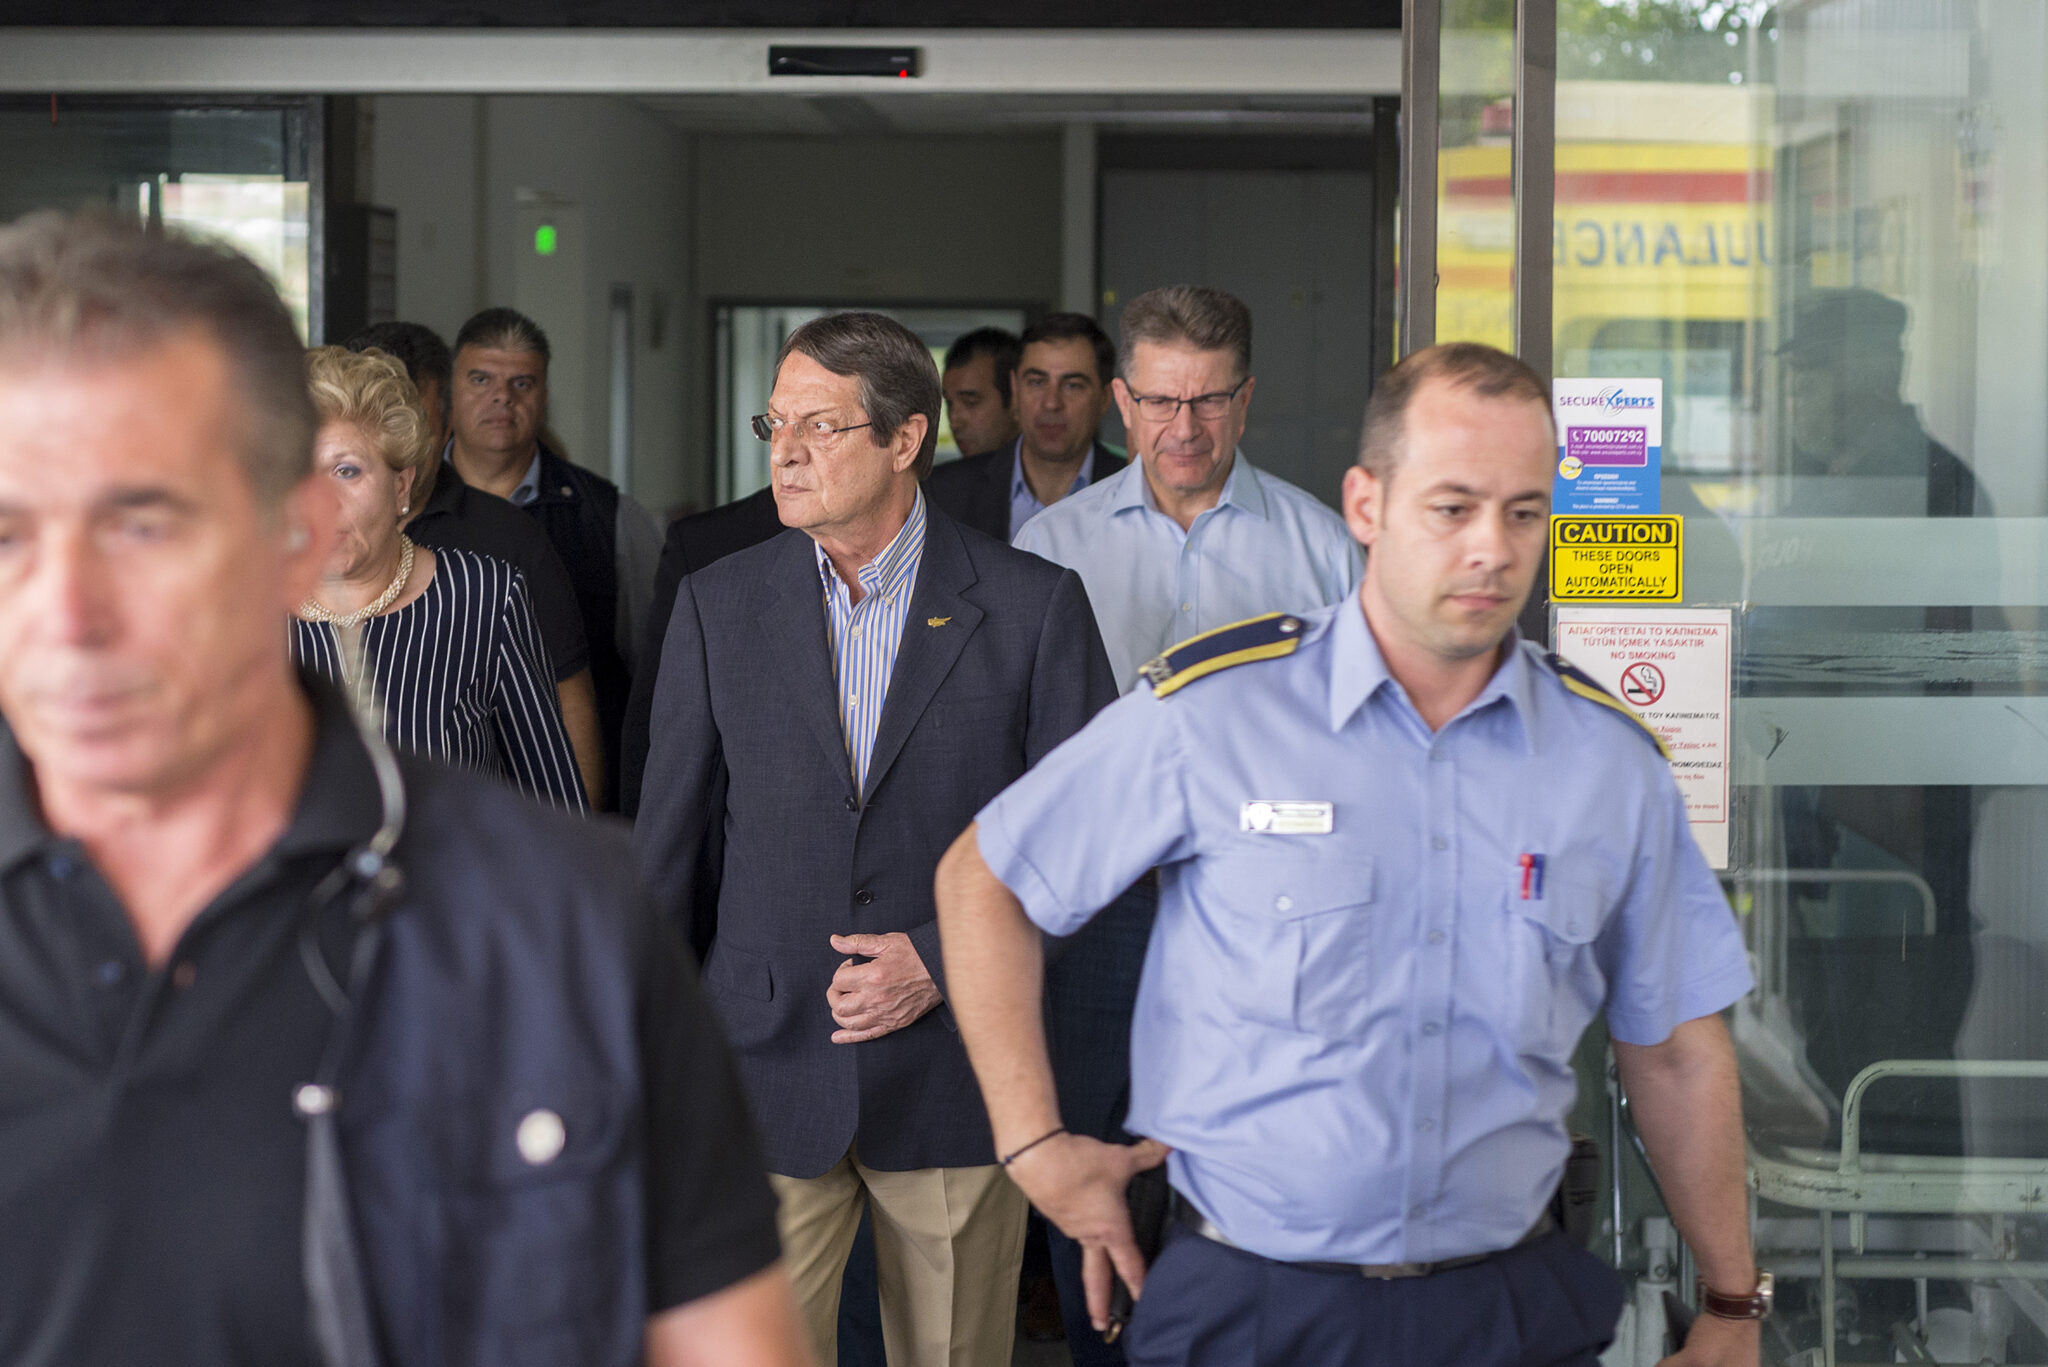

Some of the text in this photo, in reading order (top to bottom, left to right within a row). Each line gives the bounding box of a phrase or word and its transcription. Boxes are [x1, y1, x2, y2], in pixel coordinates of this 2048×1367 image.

[1559, 389, 1655, 411] SECUREXPERTS
[1583, 429, 1644, 443] 70007292
[1563, 523, 1667, 543] CAUTION
[1572, 550, 1661, 561] THESE DOORS
[1599, 564, 1633, 574] OPEN
[1565, 577, 1667, 587] AUTOMATICALLY
[1568, 626, 1646, 635] ΑΠΑΓΟΡΕΥΕΤΑΙ
[1610, 651, 1676, 660] NO SMOKING
